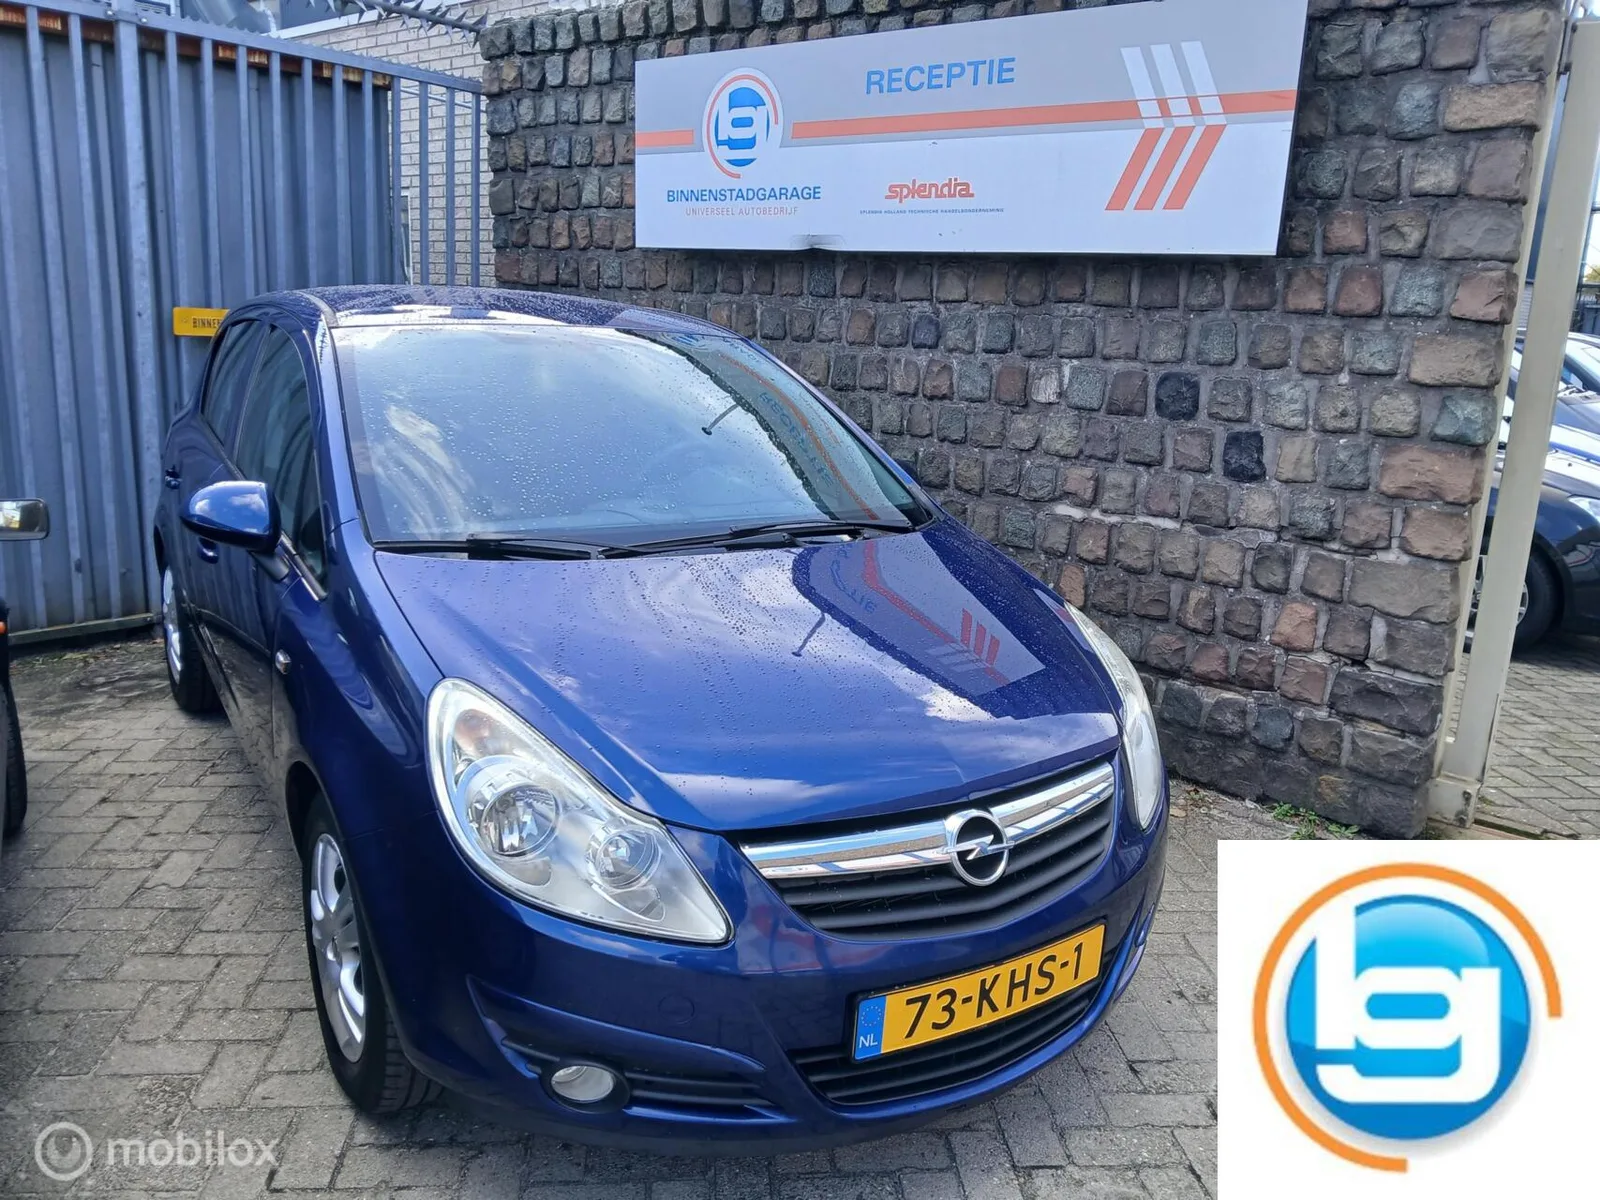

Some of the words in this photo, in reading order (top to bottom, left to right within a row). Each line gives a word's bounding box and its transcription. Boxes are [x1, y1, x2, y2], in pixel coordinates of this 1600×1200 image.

[866, 57, 1016, 94] RECEPTIE
[667, 186, 821, 202] BINNENSTADGARAGE
[884, 177, 975, 203] splendia
[685, 206, 735, 216] UNIVERSEEL
[738, 206, 799, 216] AUTOBEDRIJF
[904, 942, 1084, 1040] 73-KHS-1
[858, 1034, 878, 1049] NL
